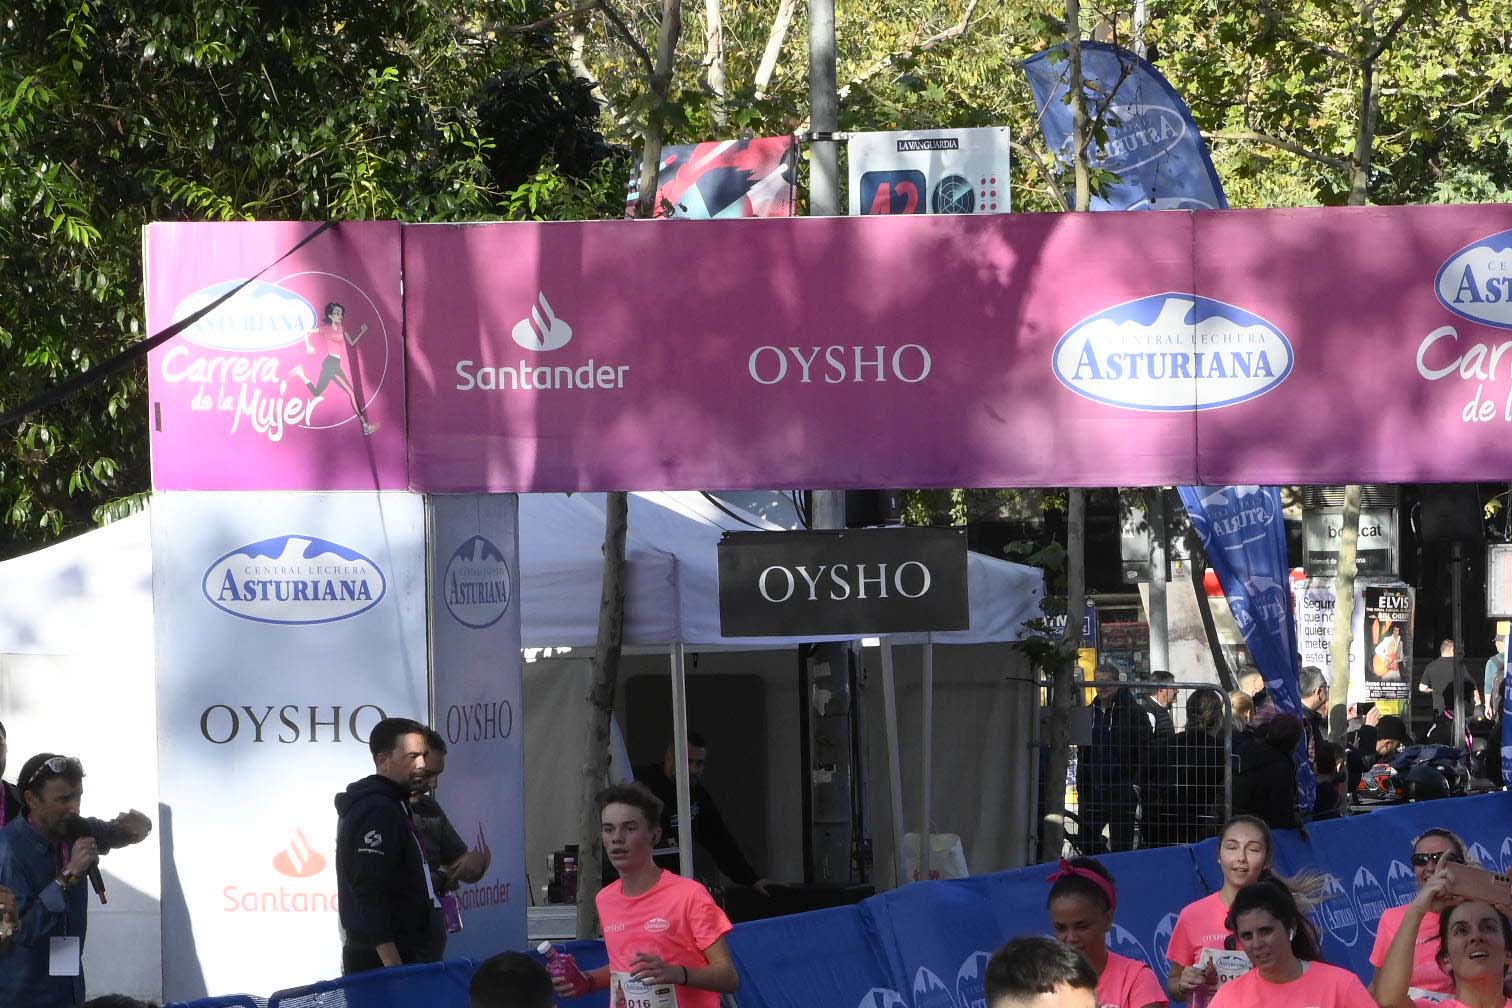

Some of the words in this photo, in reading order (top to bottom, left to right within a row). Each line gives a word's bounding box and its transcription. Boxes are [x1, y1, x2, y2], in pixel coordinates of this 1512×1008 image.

[1192, 331, 1267, 346] LECHERA
[161, 346, 280, 384] Carrera
[455, 359, 630, 391] Santander
[748, 343, 933, 387] OYSHO
[1071, 336, 1276, 382] ASTURIANA
[191, 388, 213, 412] de
[214, 388, 236, 412] la
[230, 378, 325, 442] Mujer
[1462, 383, 1498, 423] de
[216, 568, 373, 602] ASTURIANA
[758, 561, 932, 603] OYSHO
[1378, 596, 1410, 609] ELVIS
[200, 703, 388, 745] OYSHO
[446, 699, 513, 745] OYSHO
[628, 999, 651, 1008] 016
